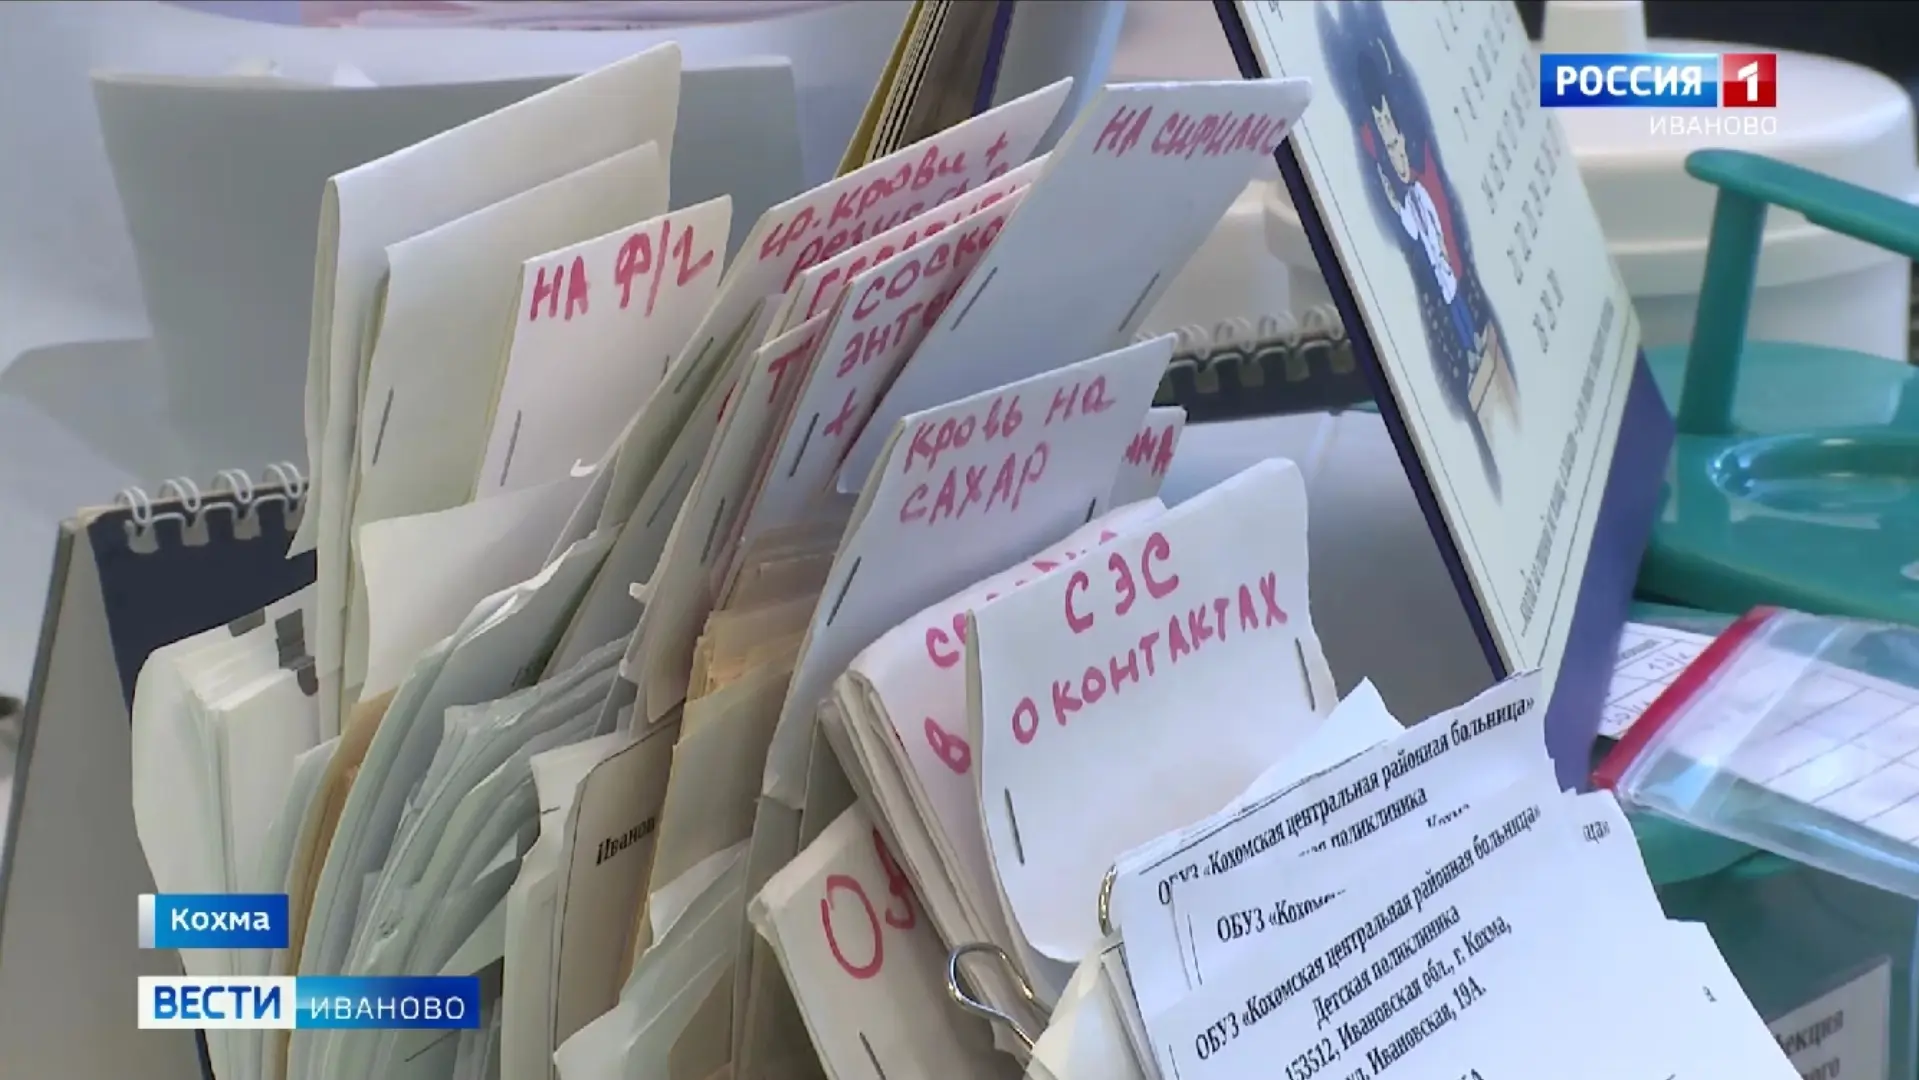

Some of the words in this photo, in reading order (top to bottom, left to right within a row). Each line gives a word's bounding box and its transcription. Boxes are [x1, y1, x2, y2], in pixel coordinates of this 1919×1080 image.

[1092, 104, 1153, 158] НА
[529, 255, 589, 321] НА
[899, 441, 1050, 526] САХАР
[1064, 531, 1181, 634] СЭС
[1285, 772, 1380, 838] центральная
[1380, 733, 1450, 790] районная
[1195, 1012, 1240, 1061] ОБУЗ
[1326, 895, 1415, 968] центральная
[1411, 848, 1475, 910] районная
[1217, 907, 1266, 943] ОБУЗ
[1312, 971, 1373, 1031] Детская
[1371, 905, 1462, 981] поликлиника
[1335, 977, 1424, 1051] Ивановская
[1462, 914, 1514, 959] Кохма,
[1365, 1002, 1458, 1076] Ивановская,
